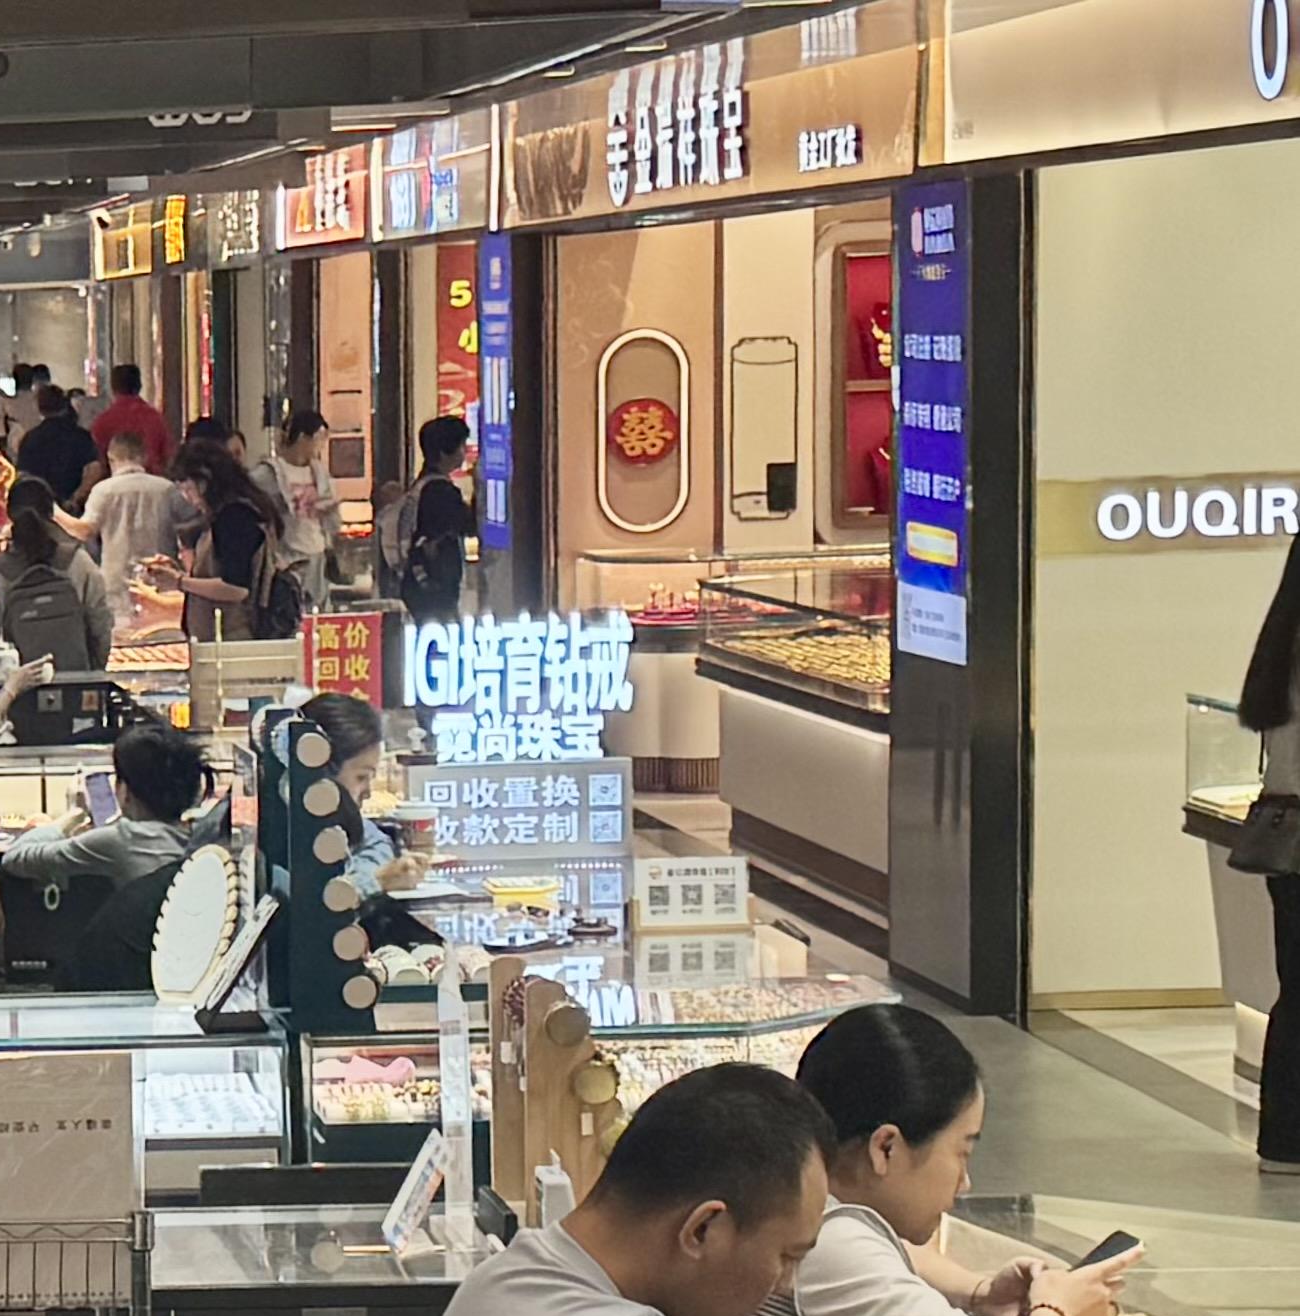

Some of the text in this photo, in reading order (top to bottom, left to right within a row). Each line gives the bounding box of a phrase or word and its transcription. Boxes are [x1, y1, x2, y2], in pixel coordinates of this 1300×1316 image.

[316, 622, 371, 651] 高价
[317, 656, 371, 682] 回收
[403, 610, 634, 714] IGI培育钻戒
[424, 774, 581, 809] 回收置换
